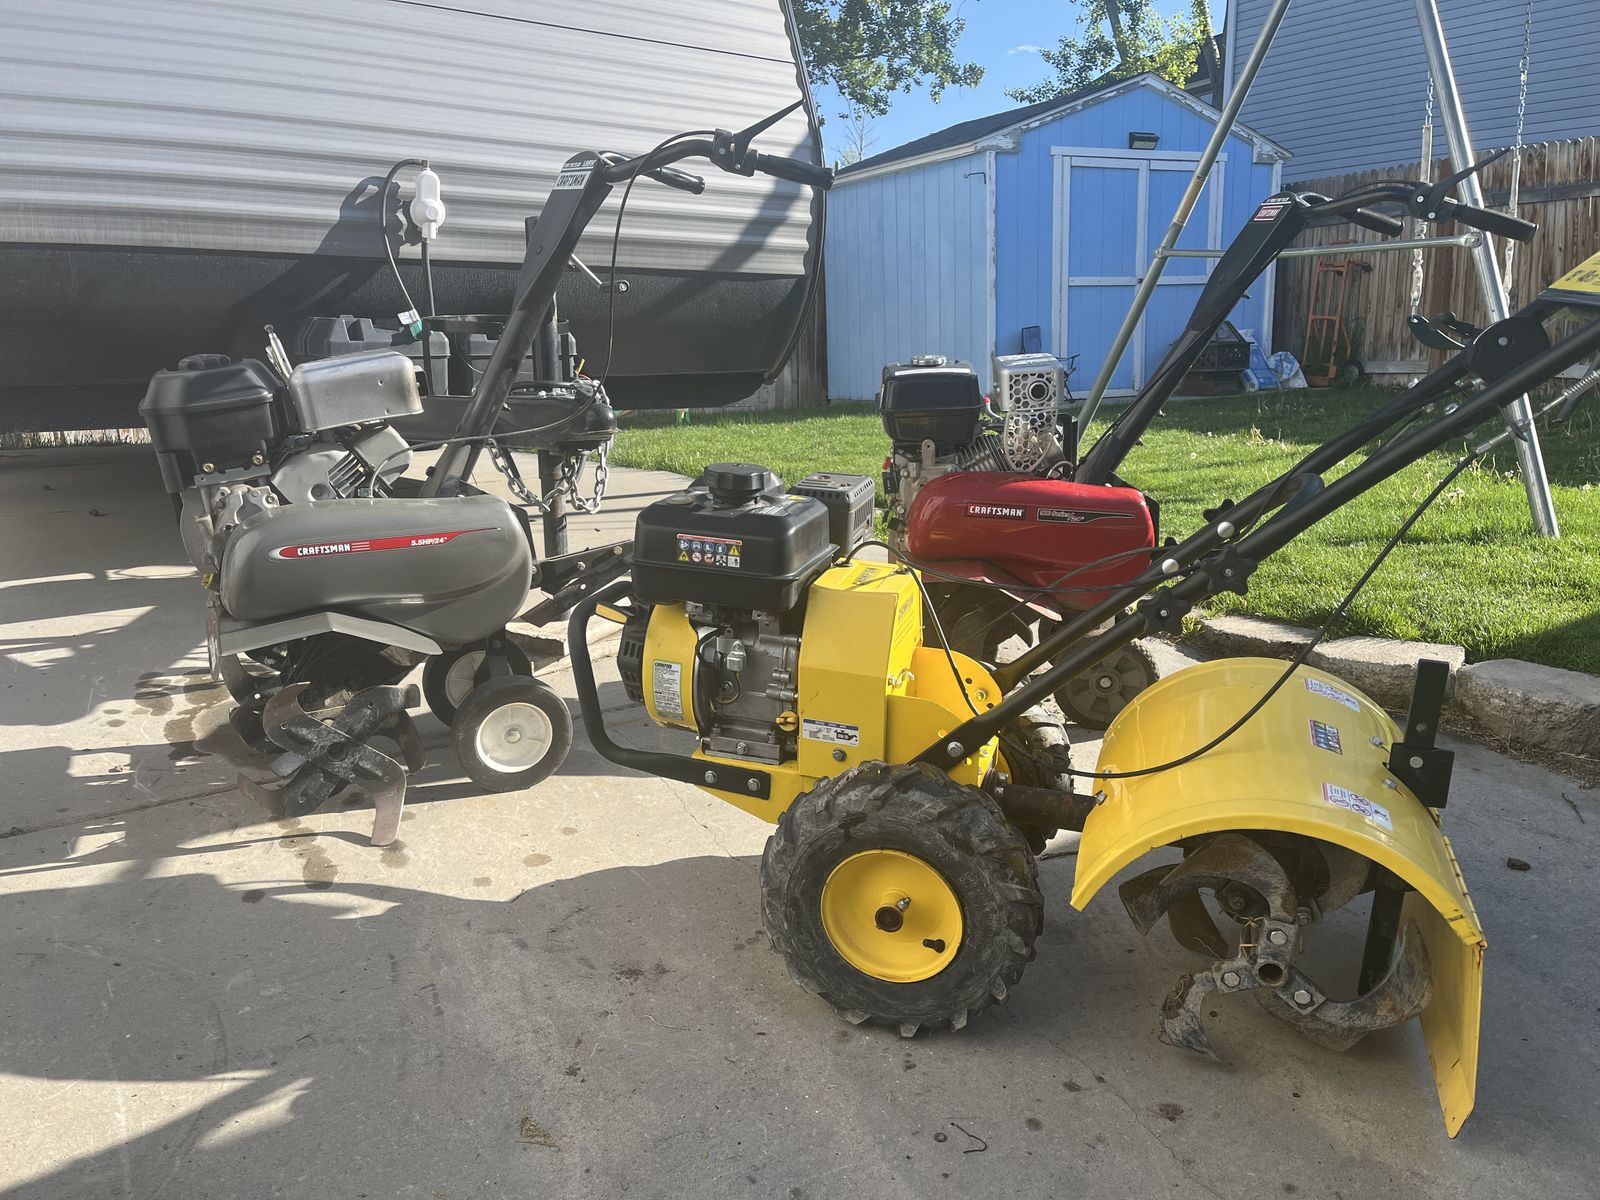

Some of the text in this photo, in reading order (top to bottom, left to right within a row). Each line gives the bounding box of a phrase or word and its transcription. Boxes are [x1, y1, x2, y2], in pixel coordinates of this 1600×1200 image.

[969, 505, 1024, 517] CRAFTSMAN
[297, 537, 448, 556] CRAFTSMAN 5.5HP/24"
